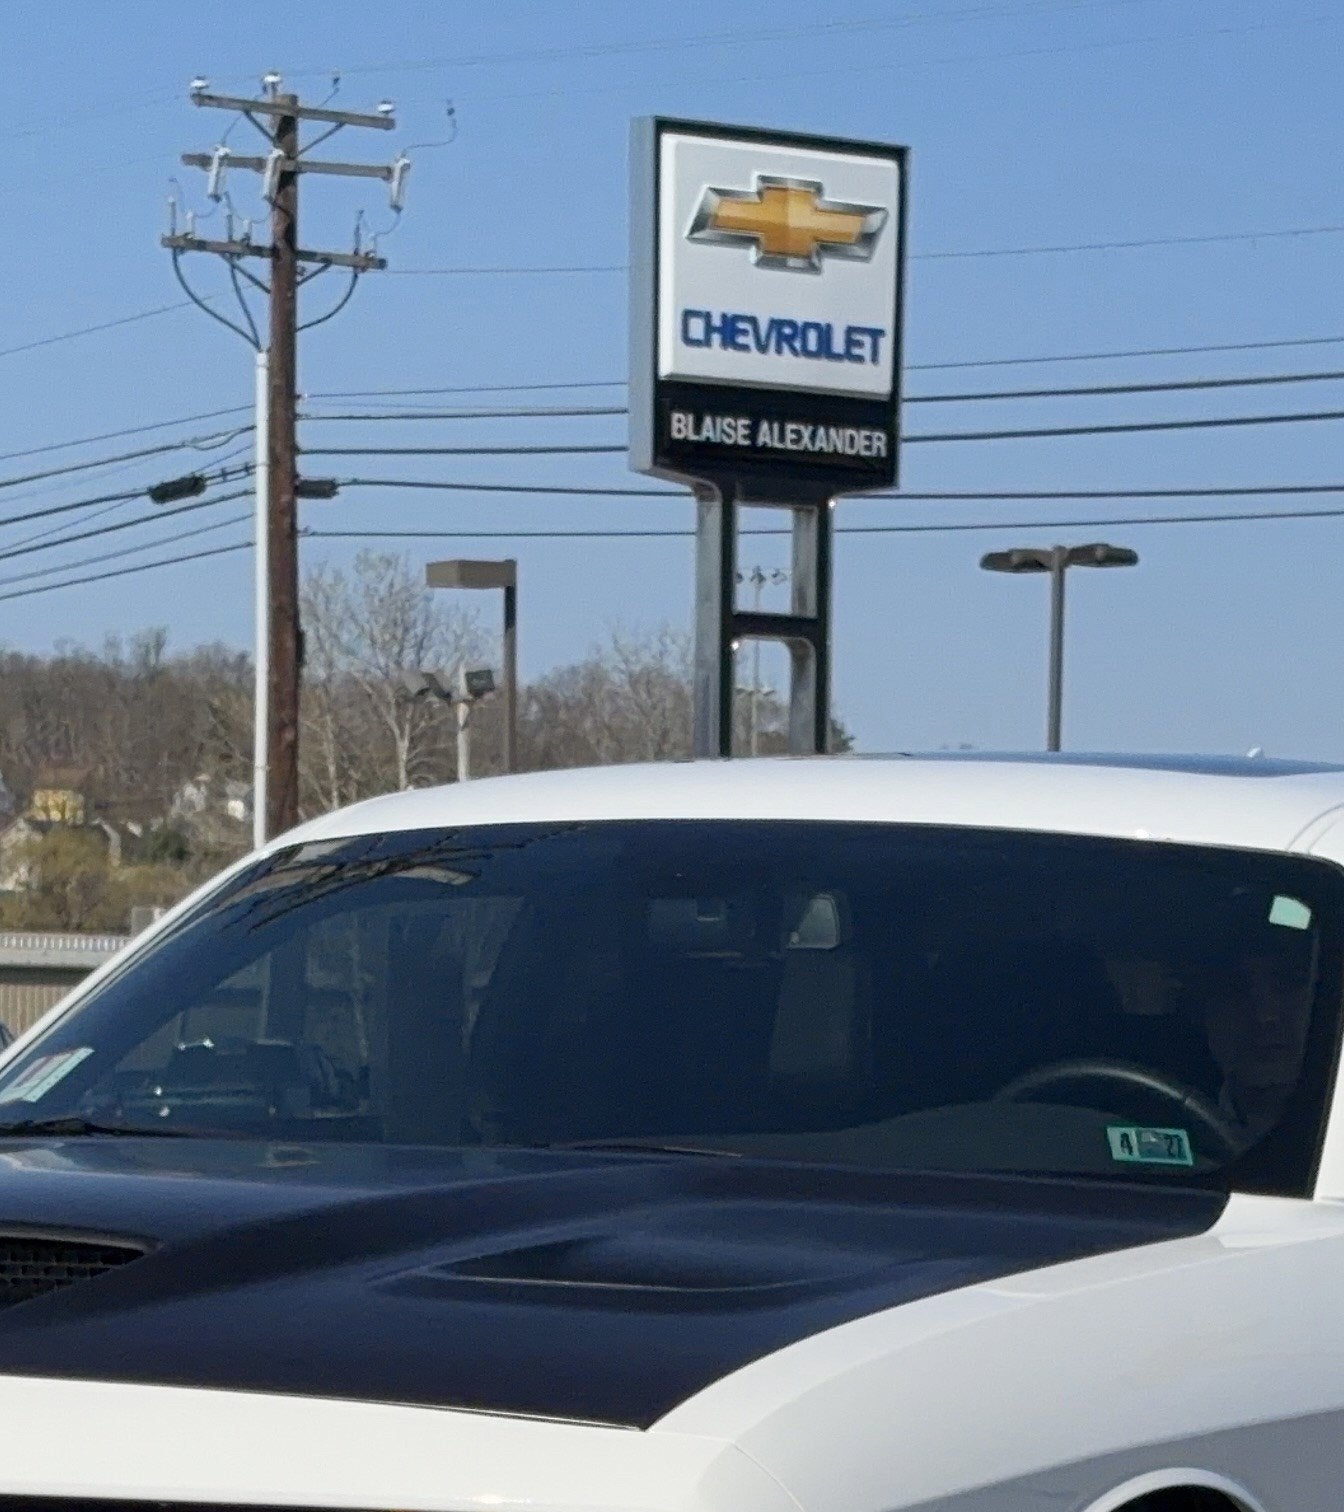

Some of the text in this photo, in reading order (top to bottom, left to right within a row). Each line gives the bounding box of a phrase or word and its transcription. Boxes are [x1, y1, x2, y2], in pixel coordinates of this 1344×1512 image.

[681, 308, 886, 365] CHEVROLET
[670, 412, 887, 458] BLAISE ALEXANDER
